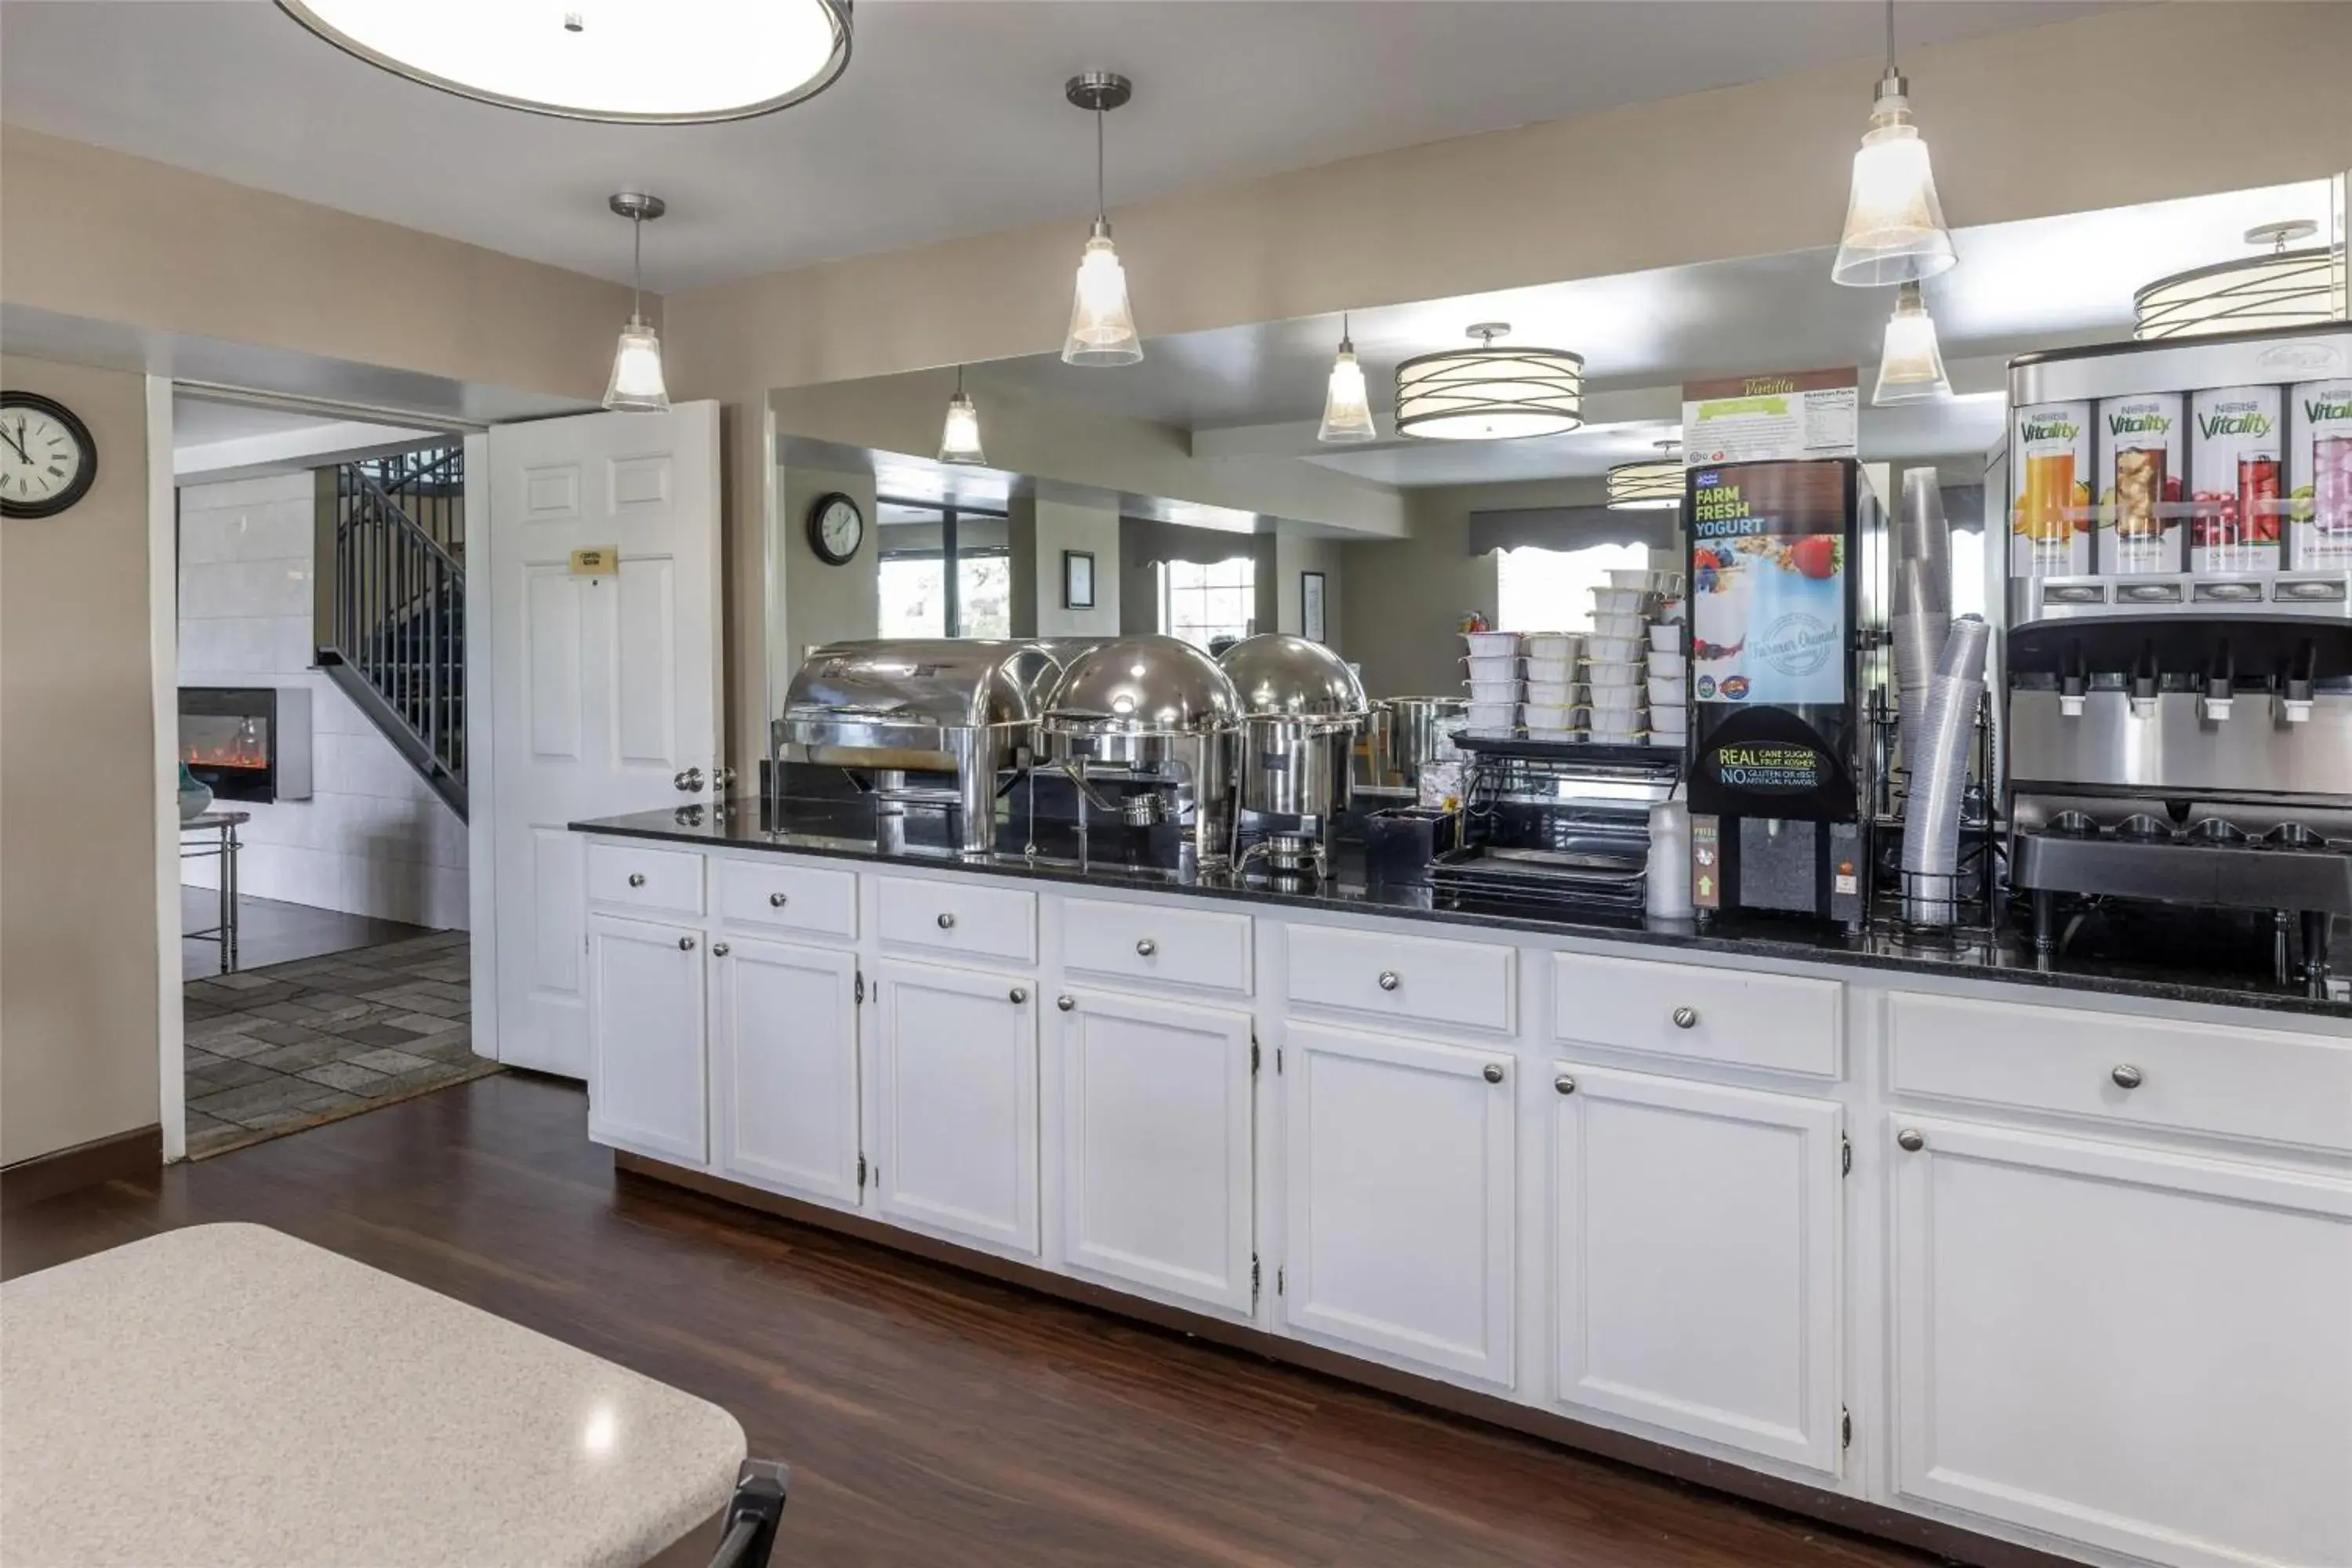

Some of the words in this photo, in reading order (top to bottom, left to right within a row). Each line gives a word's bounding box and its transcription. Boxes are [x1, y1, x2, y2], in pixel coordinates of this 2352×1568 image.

[1744, 376, 1795, 396] Vanilla
[2021, 421, 2080, 444] Vitality
[2109, 413, 2172, 437] Vitality
[2198, 413, 2273, 440] Vitality
[1696, 486, 1740, 505] FARM
[1696, 502, 1749, 521] FRESH
[1696, 517, 1766, 536] YOGURT
[1719, 749, 1759, 766] REAL
[1721, 768, 1746, 784] NO
